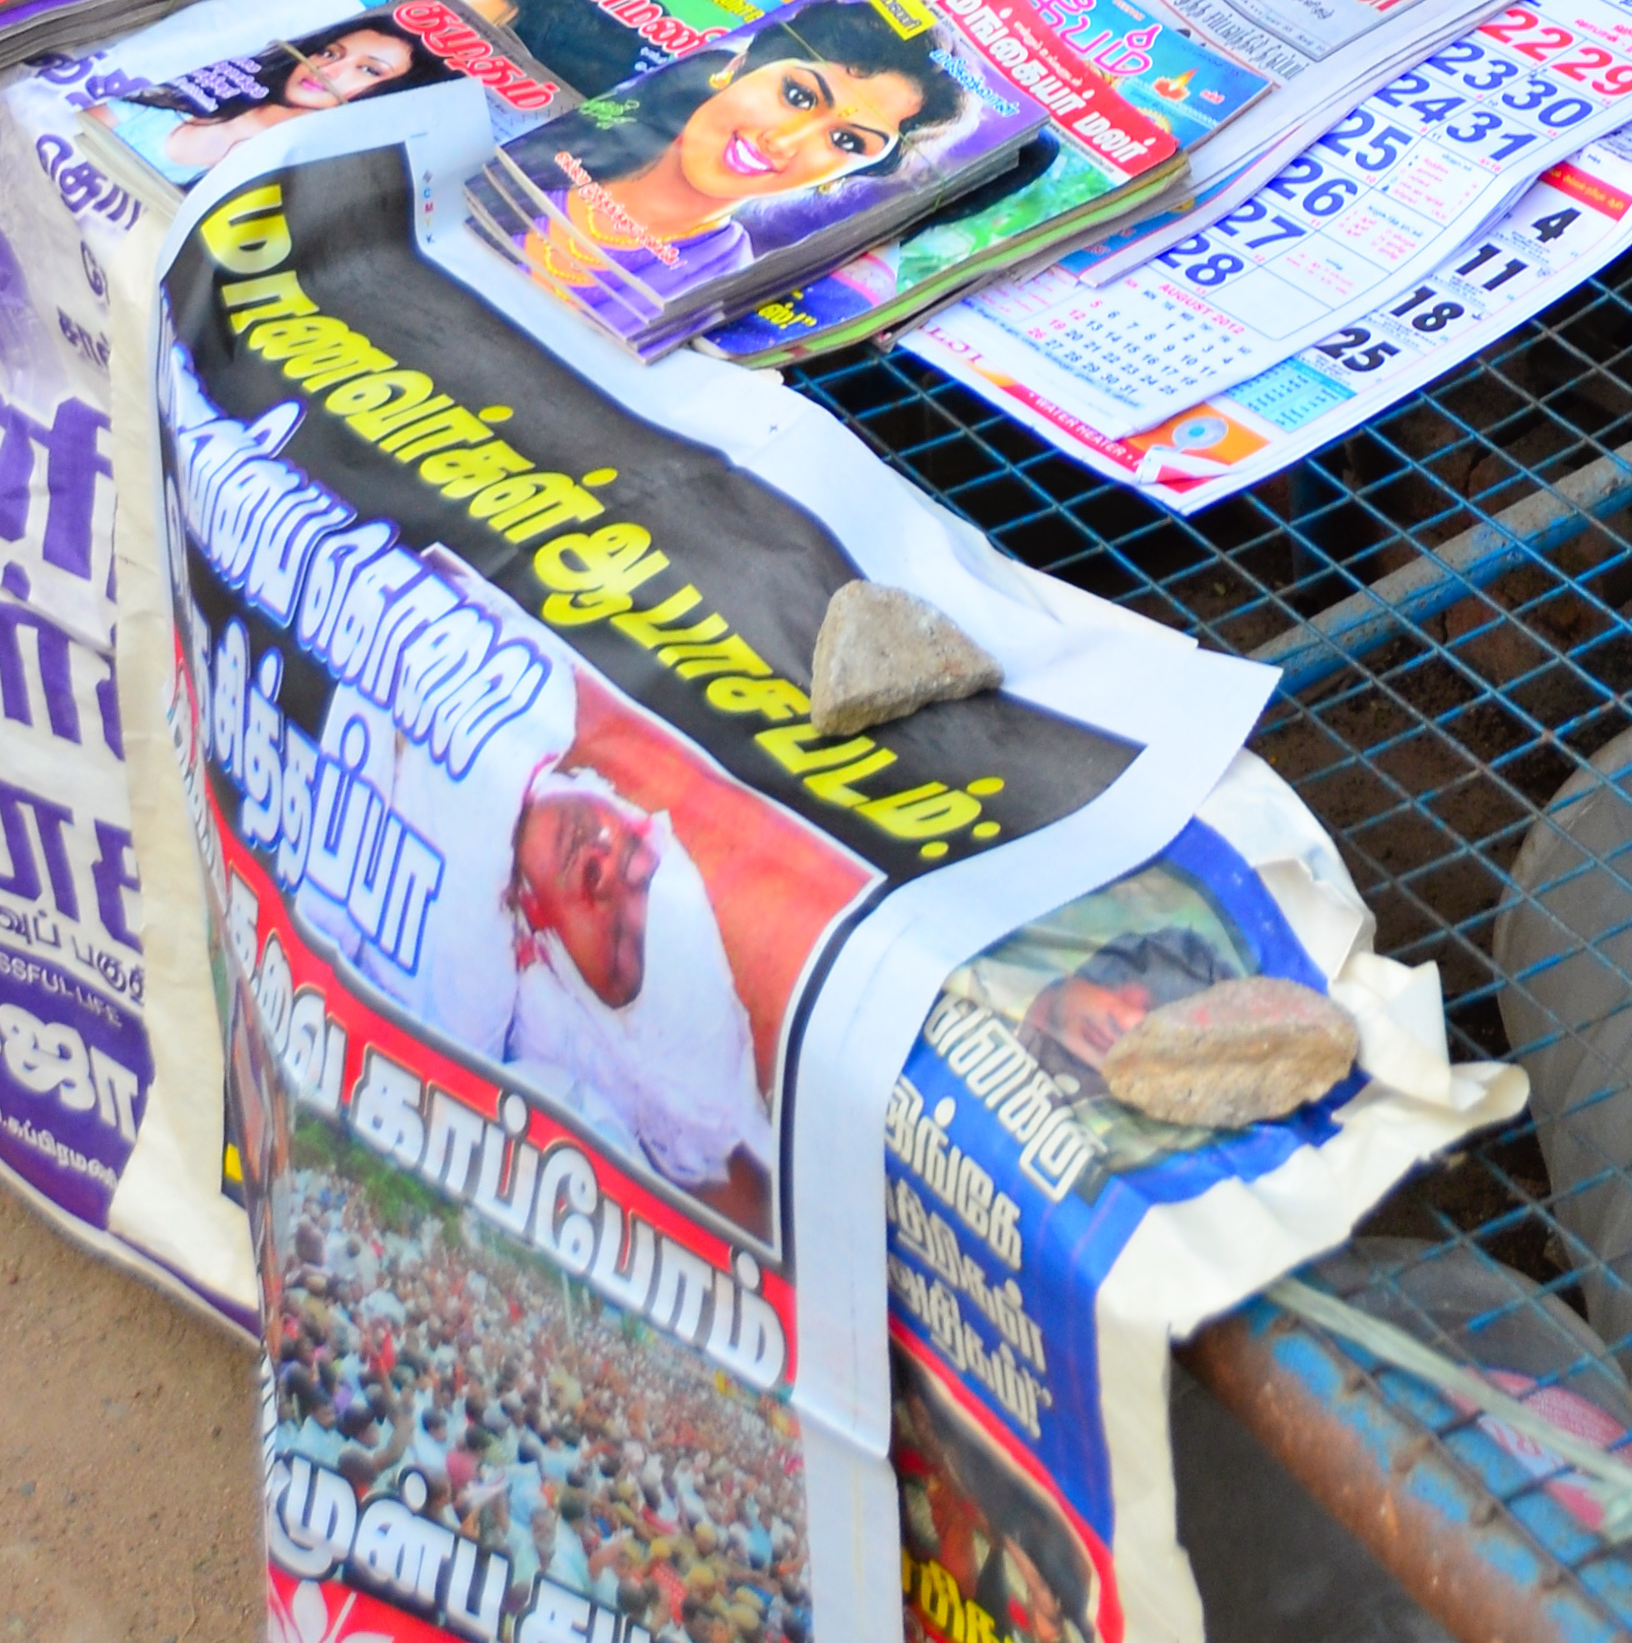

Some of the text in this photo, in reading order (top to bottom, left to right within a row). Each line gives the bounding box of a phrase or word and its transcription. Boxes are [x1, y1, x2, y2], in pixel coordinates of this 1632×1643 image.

[1478, 7, 1574, 63] 22
[1434, 38, 1520, 91] 23
[1382, 73, 1453, 125] 24
[1501, 77, 1594, 130] 30
[1072, 104, 1160, 167] மலர்
[1324, 108, 1416, 173] 25
[1445, 110, 1540, 161] 31
[1274, 158, 1358, 216] 26
[1220, 199, 1308, 249] 27
[1532, 205, 1583, 244] 4
[1157, 234, 1245, 286] 28
[1455, 243, 1528, 292] 11
[1159, 282, 1247, 336] AUGUST 2012
[1390, 285, 1465, 334] 18
[1314, 326, 1401, 373] 25
[200, 180, 617, 597] மாணவர்கள்
[347, 1049, 792, 1389] காப்போம்
